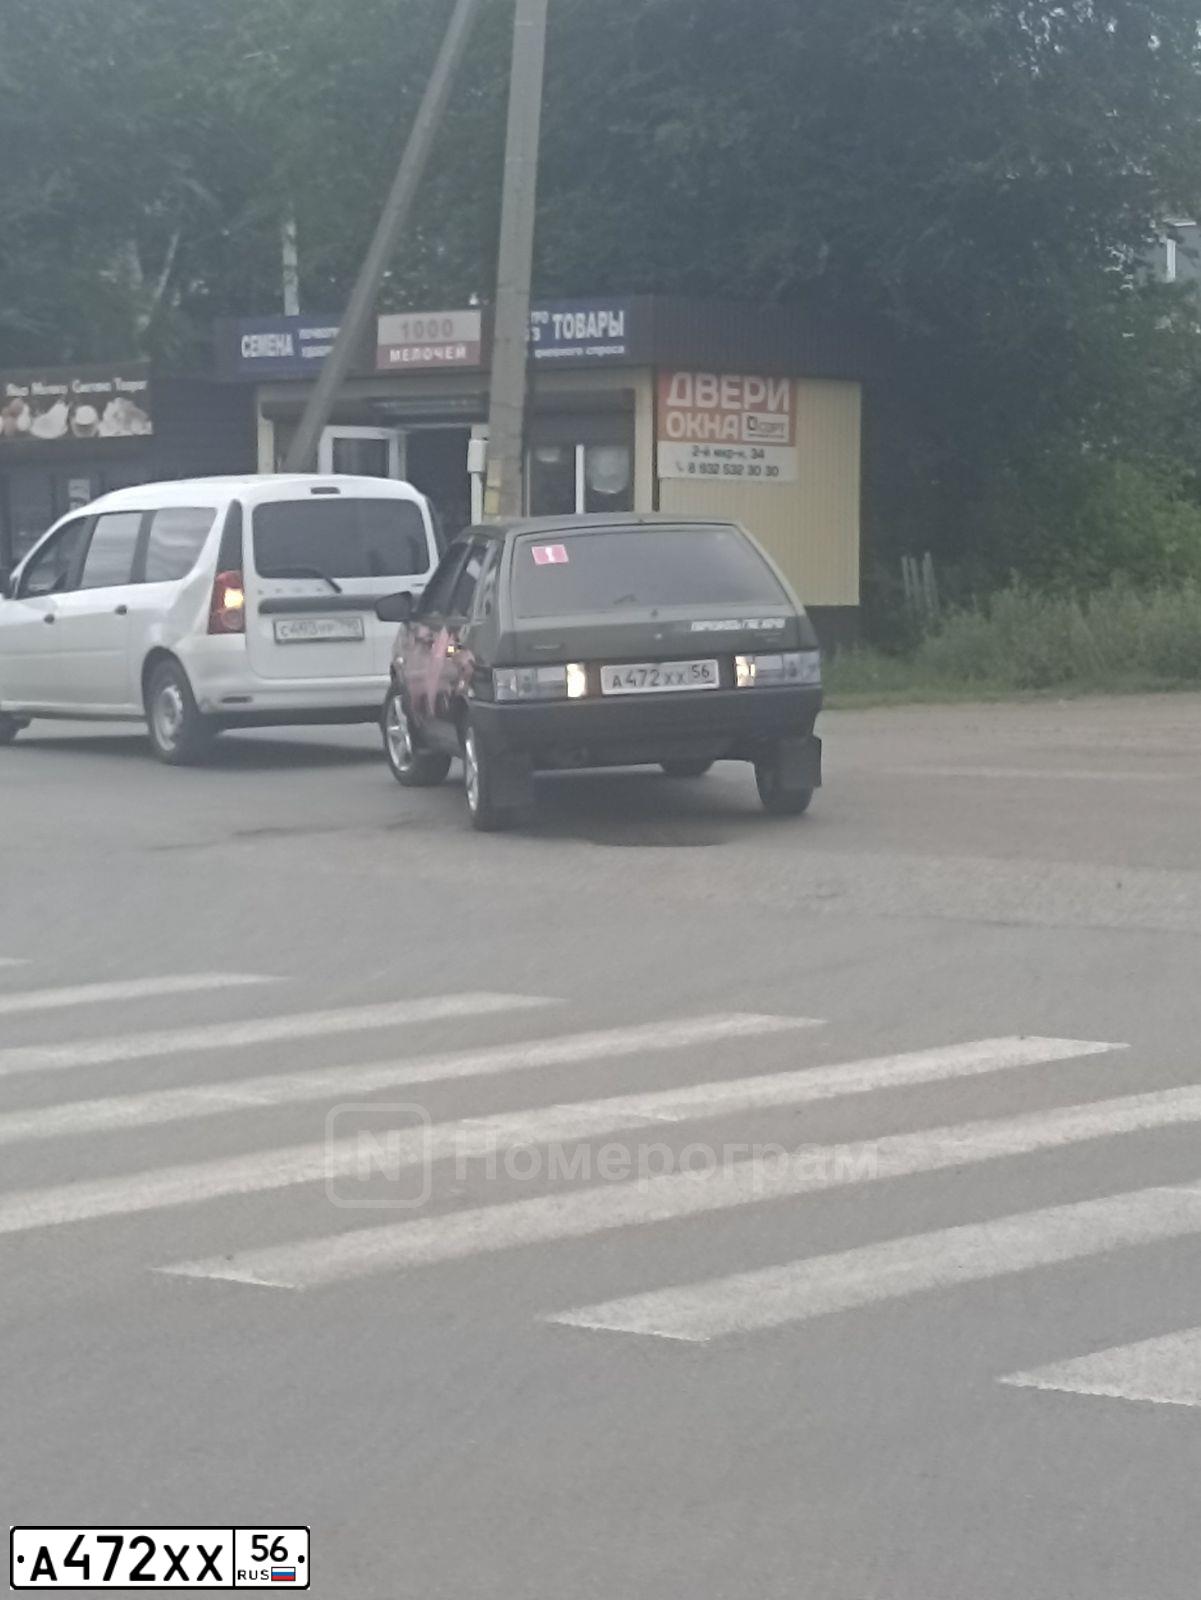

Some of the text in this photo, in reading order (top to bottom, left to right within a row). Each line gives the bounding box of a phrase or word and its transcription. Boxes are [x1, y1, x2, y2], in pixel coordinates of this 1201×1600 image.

[401, 319, 454, 342] 1000
[552, 310, 625, 340] ТОВАРЫ
[666, 372, 790, 412] ДВЕРИ
[666, 411, 739, 440] ОКНА
[691, 664, 710, 679] 56
